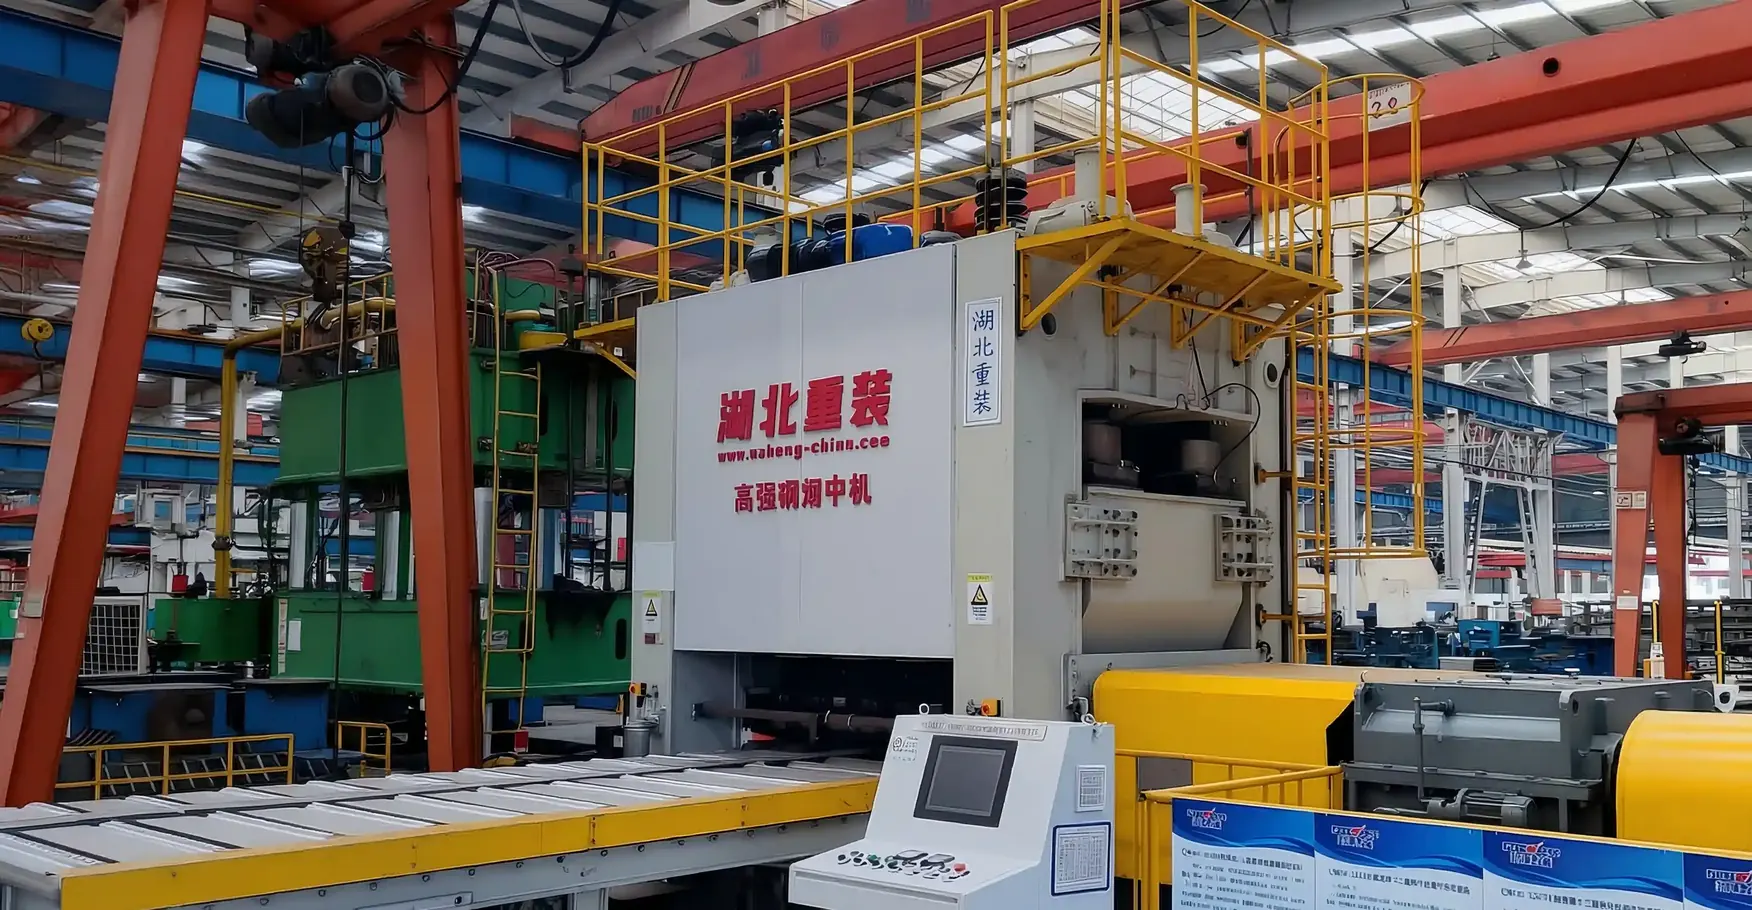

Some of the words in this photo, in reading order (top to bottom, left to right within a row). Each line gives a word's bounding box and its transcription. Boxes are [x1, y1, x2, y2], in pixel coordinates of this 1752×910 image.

[716, 369, 893, 444] 湖北重装
[972, 309, 994, 415] 湖北重装
